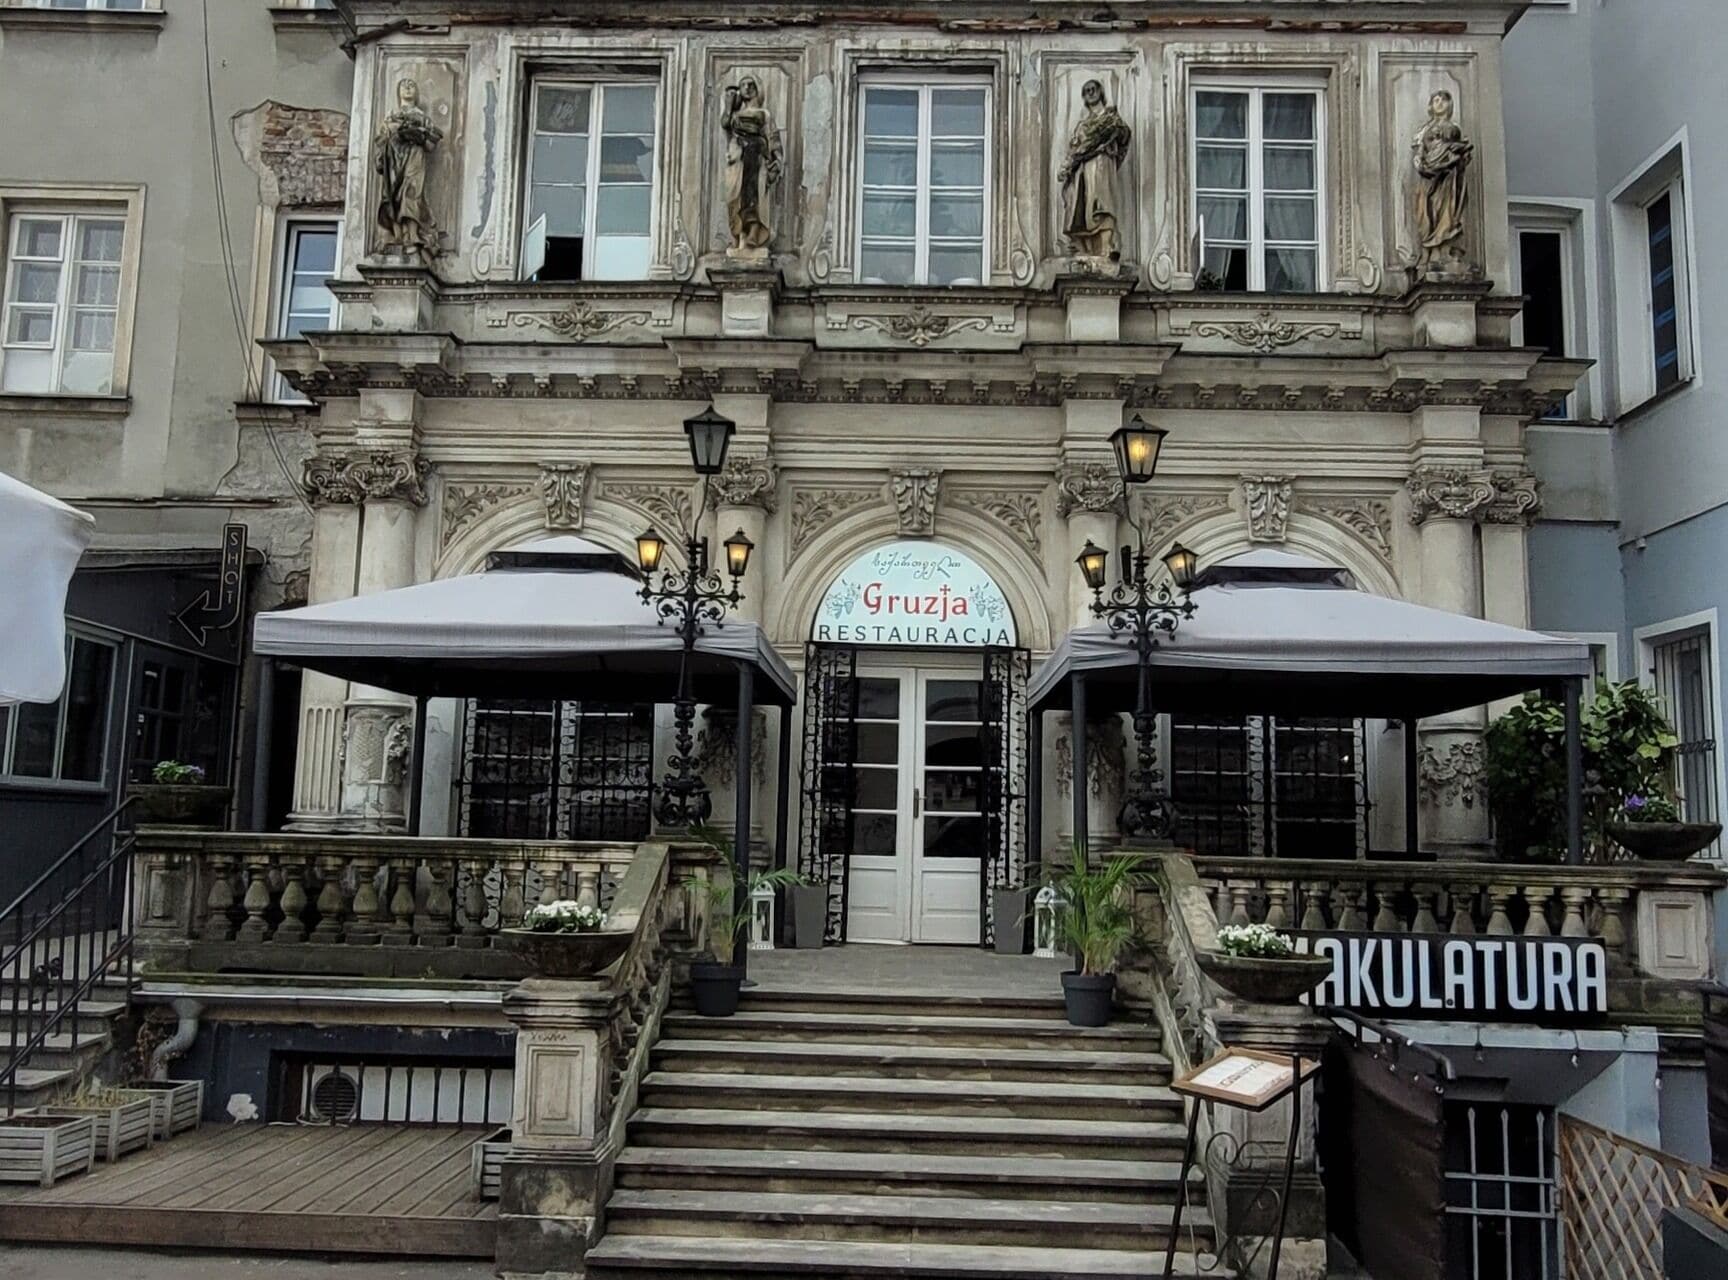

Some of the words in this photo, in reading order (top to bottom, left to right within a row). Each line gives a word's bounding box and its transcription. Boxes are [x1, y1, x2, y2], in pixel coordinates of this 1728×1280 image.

[224, 531, 239, 605] SHOT
[863, 582, 969, 622] Gruzja
[818, 624, 1010, 645] RESTAURACJA
